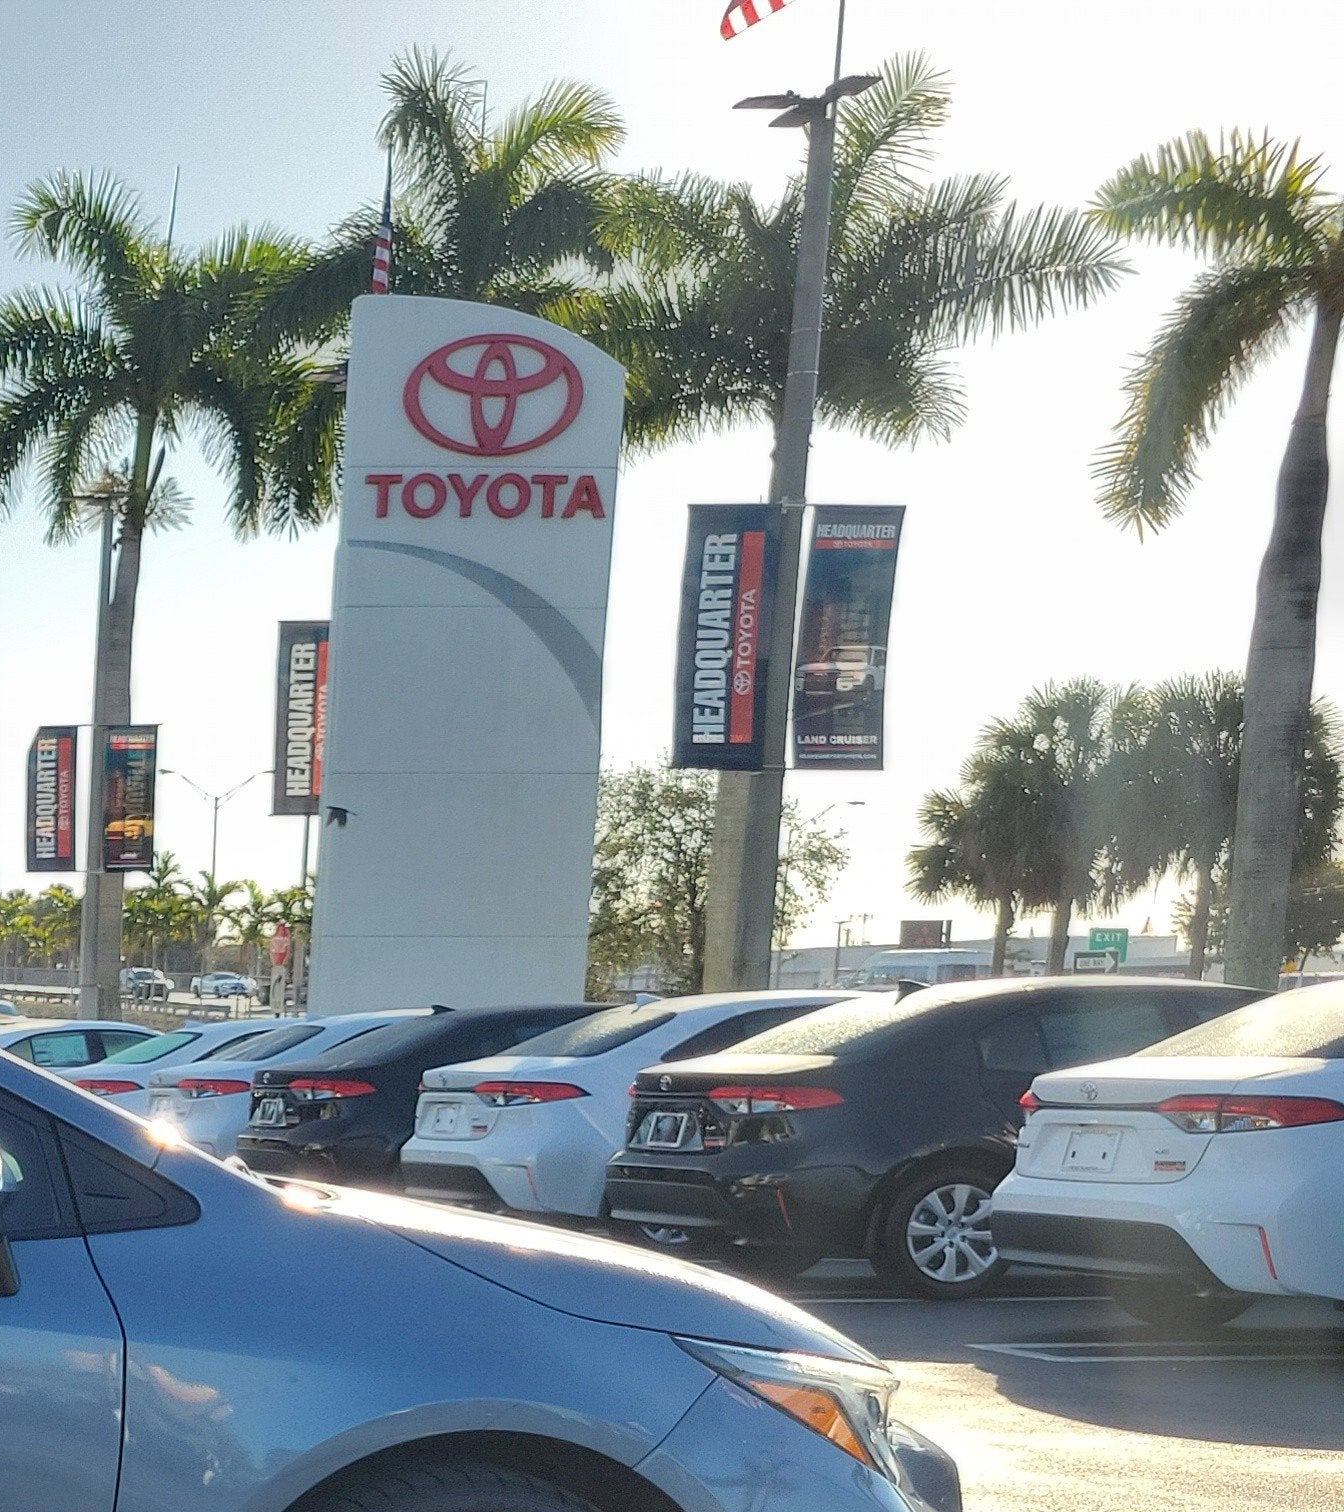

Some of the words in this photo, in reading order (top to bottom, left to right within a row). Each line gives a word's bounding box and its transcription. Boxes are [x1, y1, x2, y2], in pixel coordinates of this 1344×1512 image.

[365, 473, 606, 520] TOYOTA
[817, 524, 895, 539] HEADQUARTER
[693, 533, 737, 744] HEADQUARTER
[737, 589, 756, 668] TOYOTA
[286, 642, 316, 796] HEADQUARTER
[798, 735, 826, 744] LAND
[829, 735, 878, 744] CRUISER
[36, 738, 58, 859] HEADQUARTER
[59, 770, 70, 816] TOYOTA
[1095, 933, 1122, 942] EXIT
